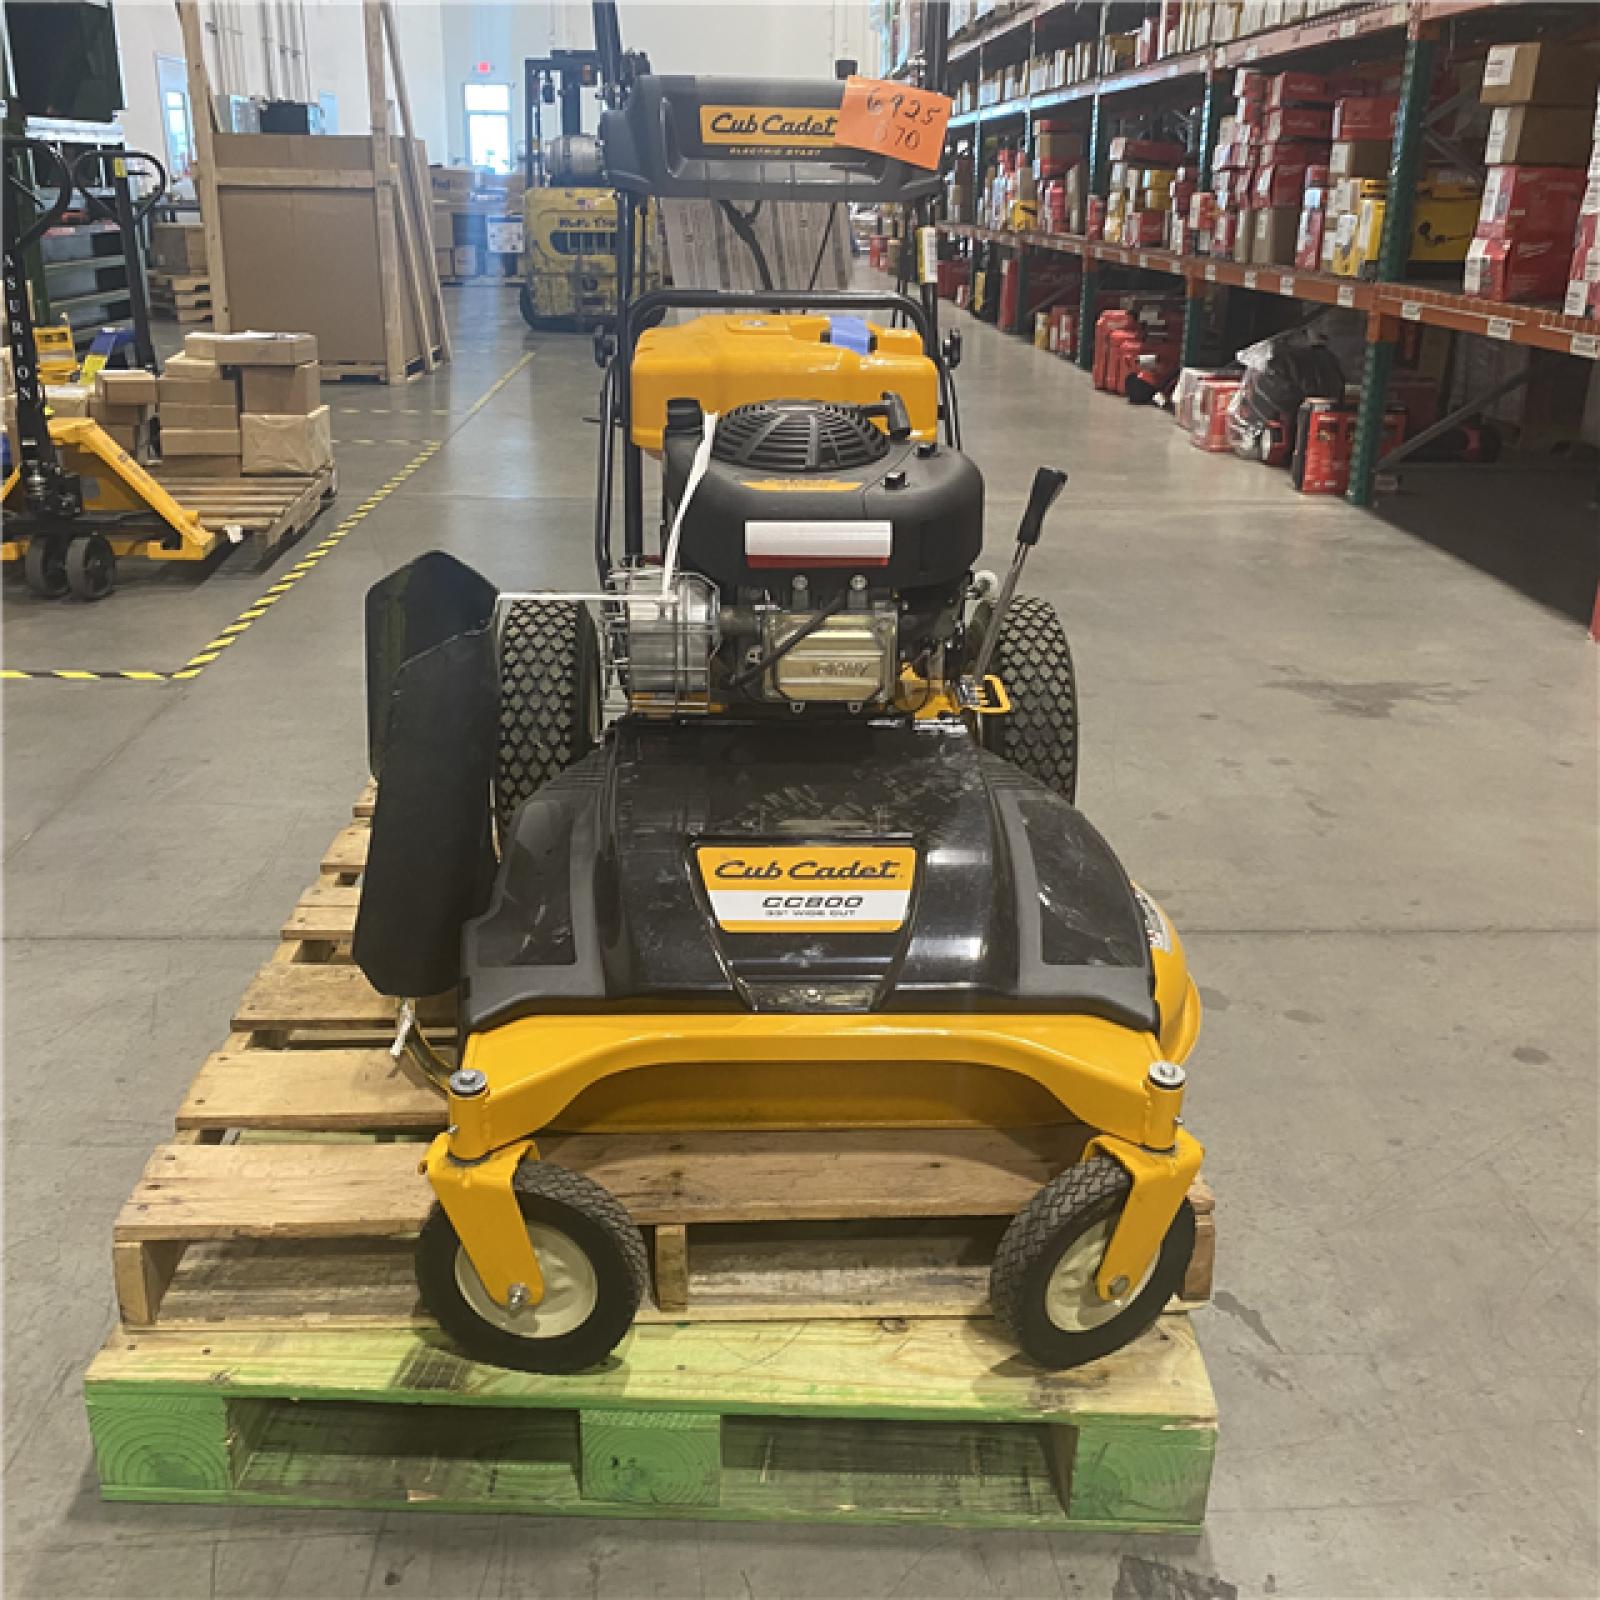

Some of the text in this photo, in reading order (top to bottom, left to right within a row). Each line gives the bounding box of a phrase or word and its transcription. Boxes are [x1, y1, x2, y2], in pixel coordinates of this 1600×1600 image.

[710, 112, 838, 136] Cub Cadet
[714, 859, 901, 880] Cub Cadet
[762, 896, 863, 908] CC800
